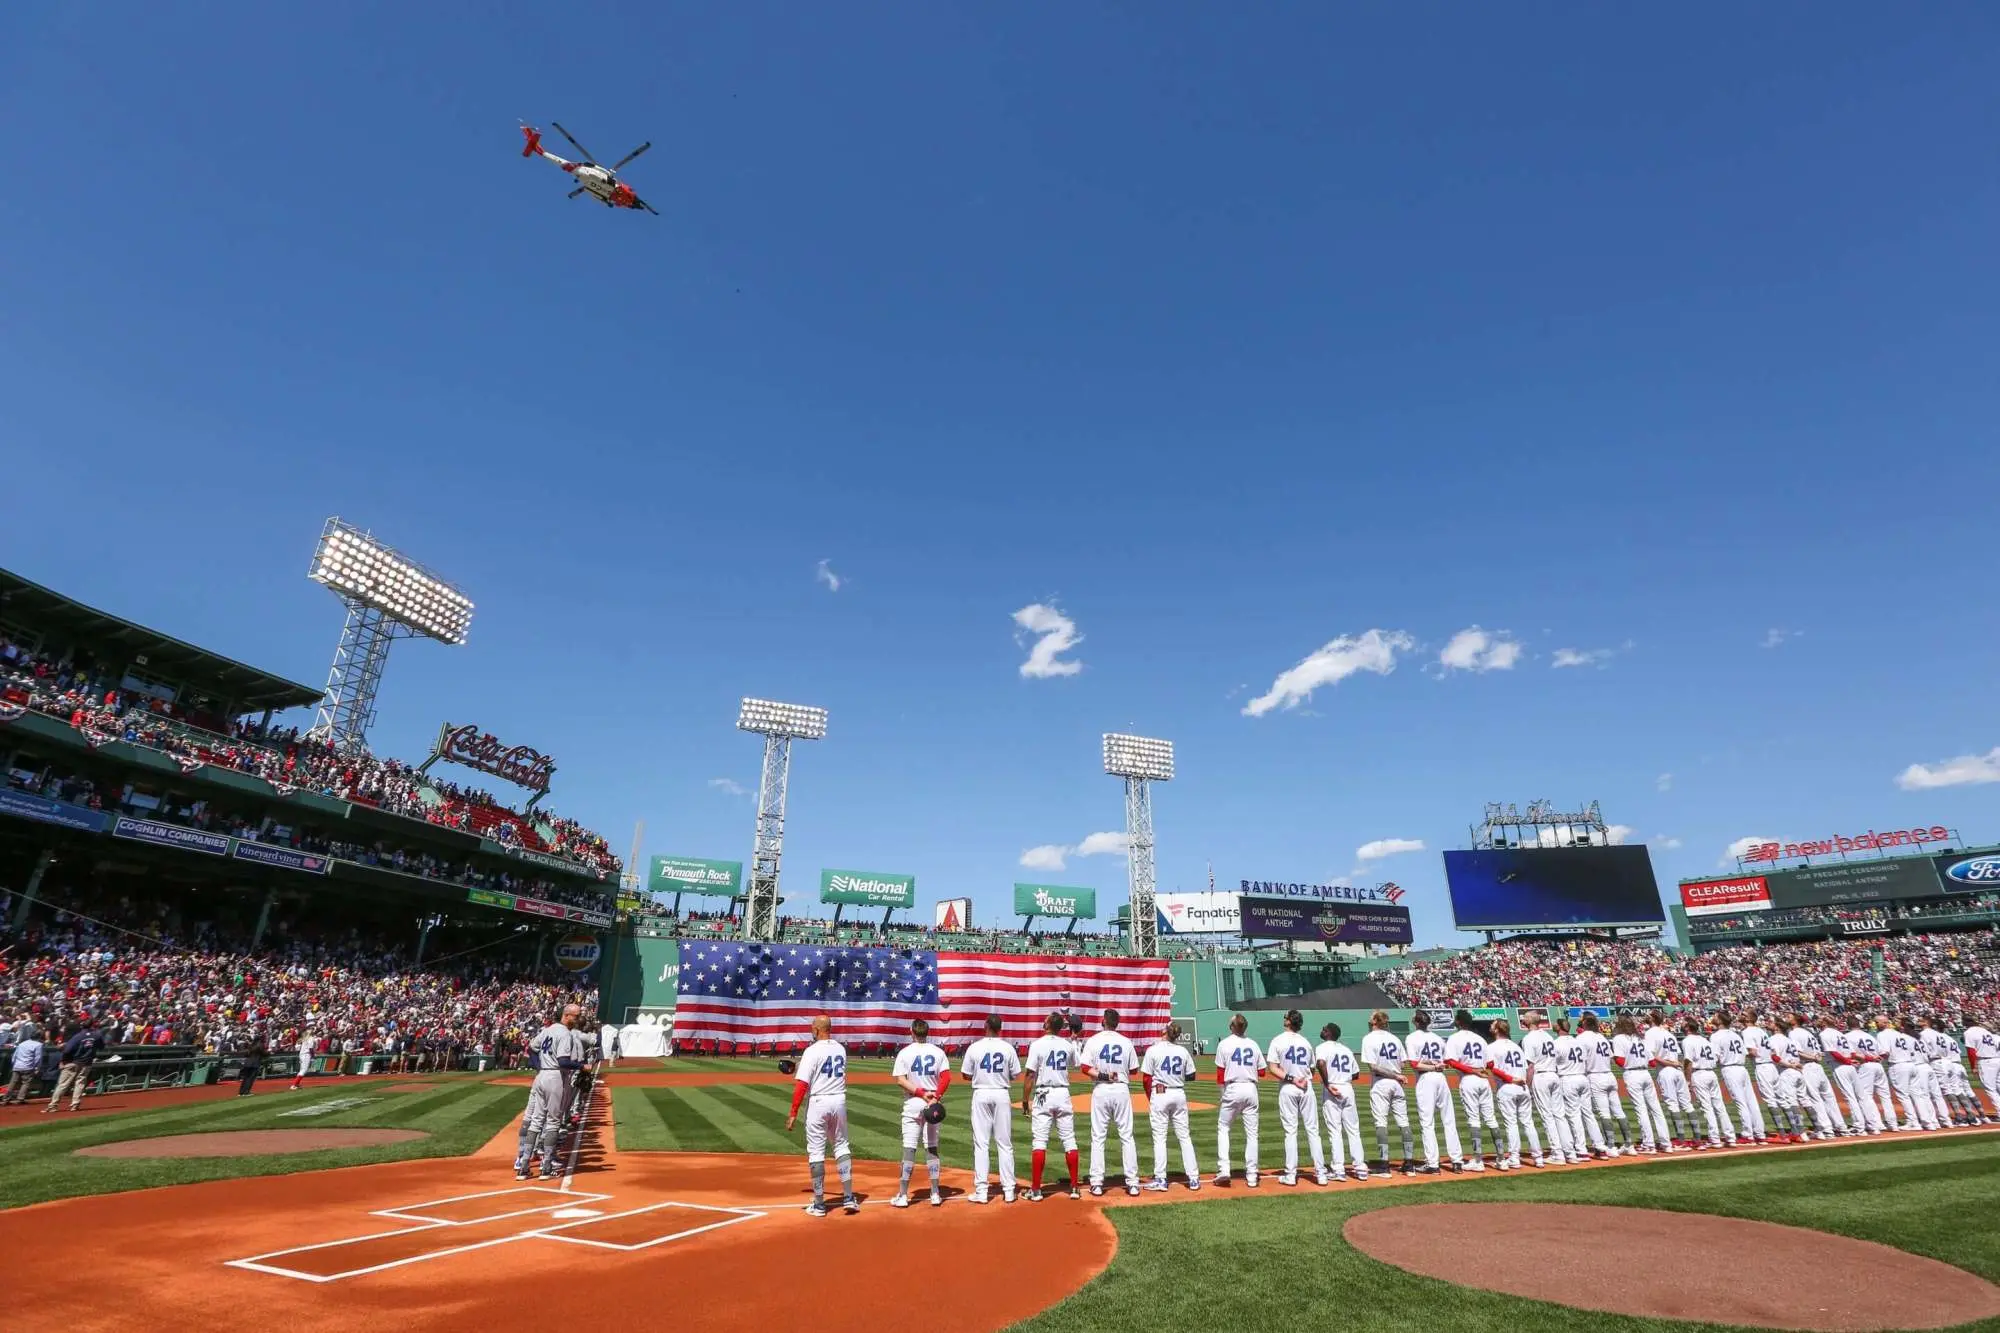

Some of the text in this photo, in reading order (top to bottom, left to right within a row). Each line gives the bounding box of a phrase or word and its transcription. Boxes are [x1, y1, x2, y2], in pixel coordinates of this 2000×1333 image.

[444, 725, 550, 789] Coca-Cola
[120, 820, 167, 837] COGHLIN
[168, 830, 227, 848] COMPANIES
[1785, 825, 1949, 858] new balance
[240, 846, 301, 865] vineyard vines
[529, 855, 588, 874] BLACK LIVES MATTER
[1851, 863, 1900, 875] CEREMONIES
[661, 866, 731, 881] Plymouth Rock
[1241, 880, 1377, 900] BANK OF AMERICA
[1688, 882, 1760, 897] CLEAResult
[1814, 876, 1888, 888] NATIONAL ANTHEM
[1036, 897, 1076, 906] DRAFT
[1041, 905, 1075, 914] KINGS
[582, 913, 610, 927] Safelite
[1187, 906, 1241, 918] Fanatics
[1252, 907, 1303, 918] OUR NATIONAL
[1265, 918, 1294, 928] ANTHEM
[1840, 920, 1887, 931] TRULY
[560, 944, 597, 957] Gulf
[658, 964, 679, 982] JIM
[1421, 1041, 1441, 1059] 42
[1463, 1042, 1483, 1059] 42
[1541, 1041, 1556, 1057] 42
[1596, 1041, 1609, 1057] 42
[1630, 1043, 1645, 1058] 42
[1663, 1037, 1678, 1053] 42
[1729, 1039, 1742, 1054] 42
[1786, 1043, 1799, 1058] 42
[1807, 1036, 1819, 1050] 42
[1837, 1035, 1849, 1050] 42
[1858, 1038, 1875, 1052] 42
[1895, 1037, 1908, 1050] 42
[1914, 1039, 1926, 1053] 42
[1936, 1036, 1947, 1049] 42
[1100, 1043, 1123, 1064] 42
[1231, 1047, 1254, 1066] 42
[1285, 1045, 1307, 1066] 42
[1379, 1042, 1397, 1060] 42
[1568, 1046, 1583, 1063] 42
[1700, 1046, 1714, 1060] 42
[821, 1055, 844, 1078] 42
[911, 1054, 936, 1076] 42
[980, 1052, 1004, 1073] 42
[1045, 1050, 1067, 1070] 42
[1161, 1055, 1183, 1075] 42
[1331, 1054, 1350, 1073] 42
[1505, 1051, 1523, 1068] 42
